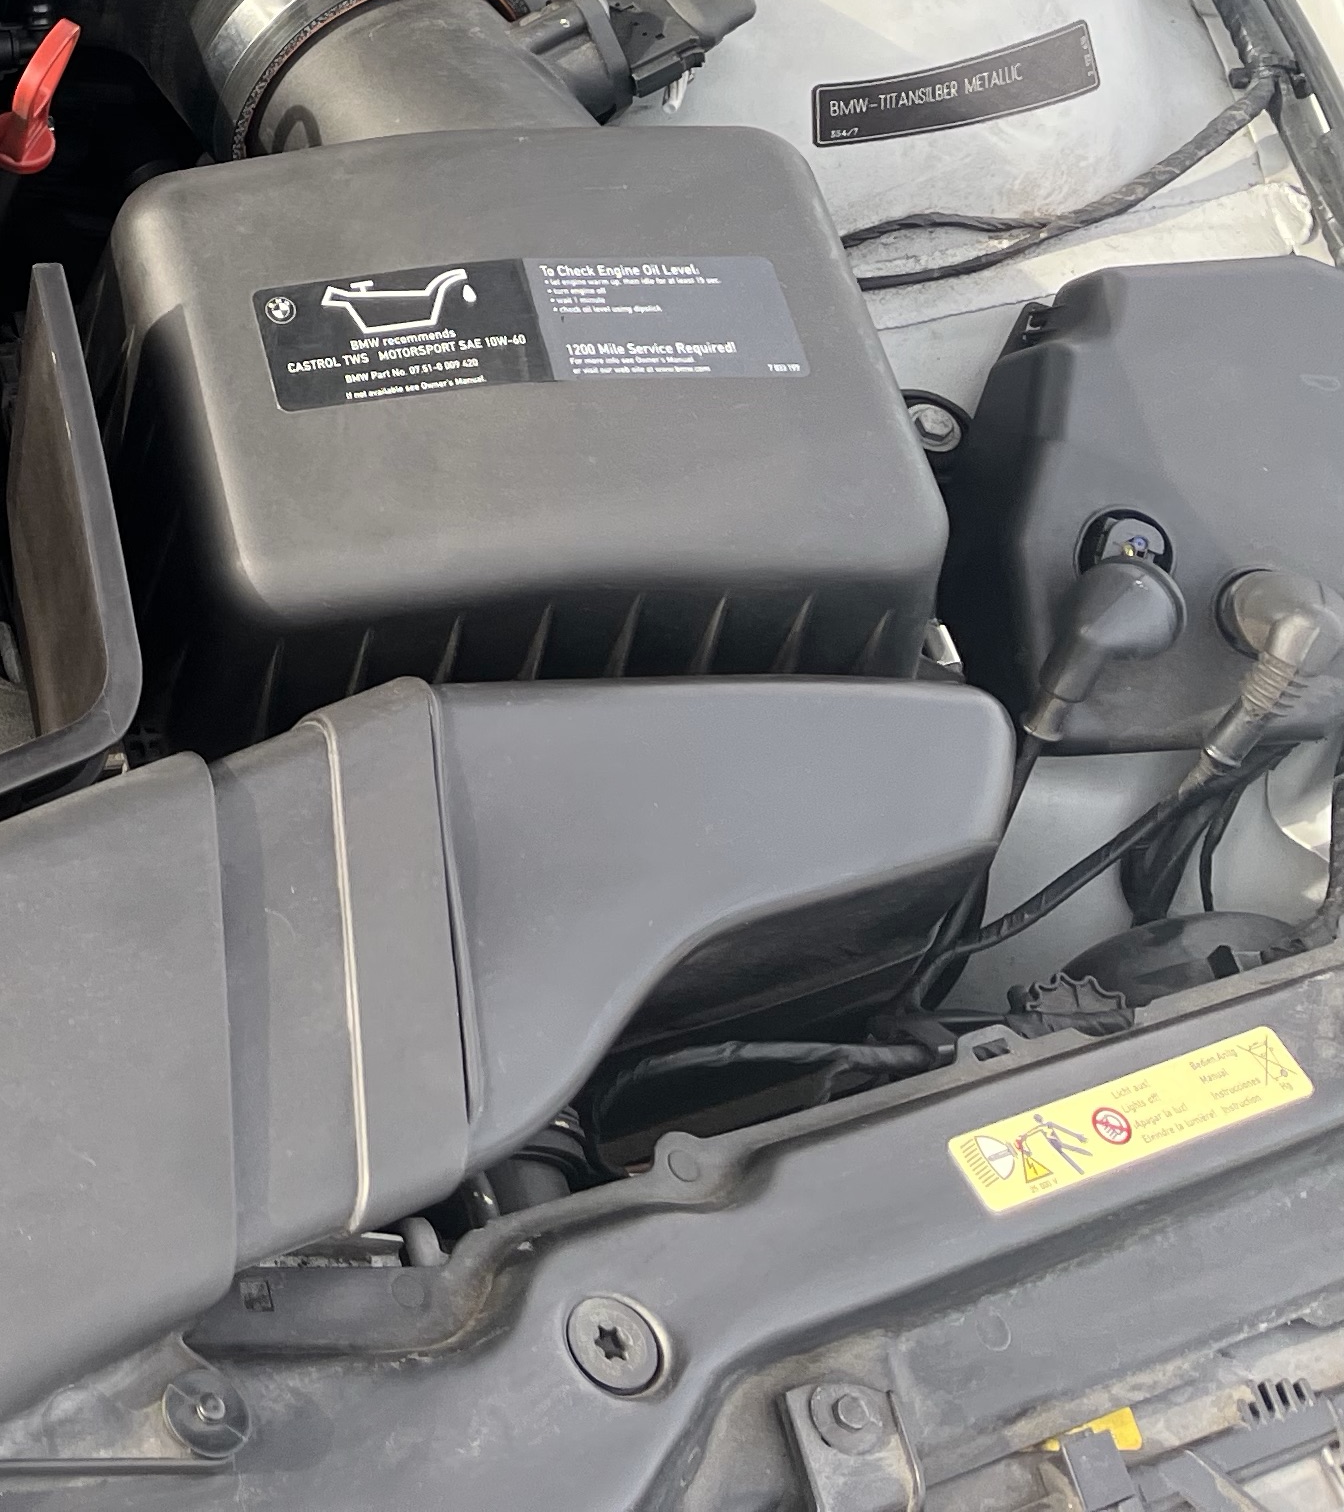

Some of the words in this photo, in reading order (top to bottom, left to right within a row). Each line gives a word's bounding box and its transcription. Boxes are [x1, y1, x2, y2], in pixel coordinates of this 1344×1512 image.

[829, 80, 958, 117] BMW-TITANSILBER
[964, 63, 1023, 95] METALLIC
[539, 264, 555, 277] To
[556, 265, 596, 277] Check
[597, 264, 641, 279] Engine
[642, 264, 661, 276] Oil
[350, 337, 379, 350] BMW
[382, 328, 457, 346] recommends
[287, 356, 342, 373] CASTROL
[341, 352, 370, 366] TWS
[377, 341, 456, 361] MOTORSPORT
[458, 338, 483, 350] SAE
[484, 334, 526, 348] 10W-60
[566, 343, 596, 356] 1200
[597, 343, 625, 355] Mile
[626, 342, 674, 355] Service
[674, 341, 737, 356] Required!
[344, 373, 369, 383] BMW
[371, 370, 391, 380] Part
[392, 367, 408, 377] No.
[1199, 1068, 1229, 1084] Manual
